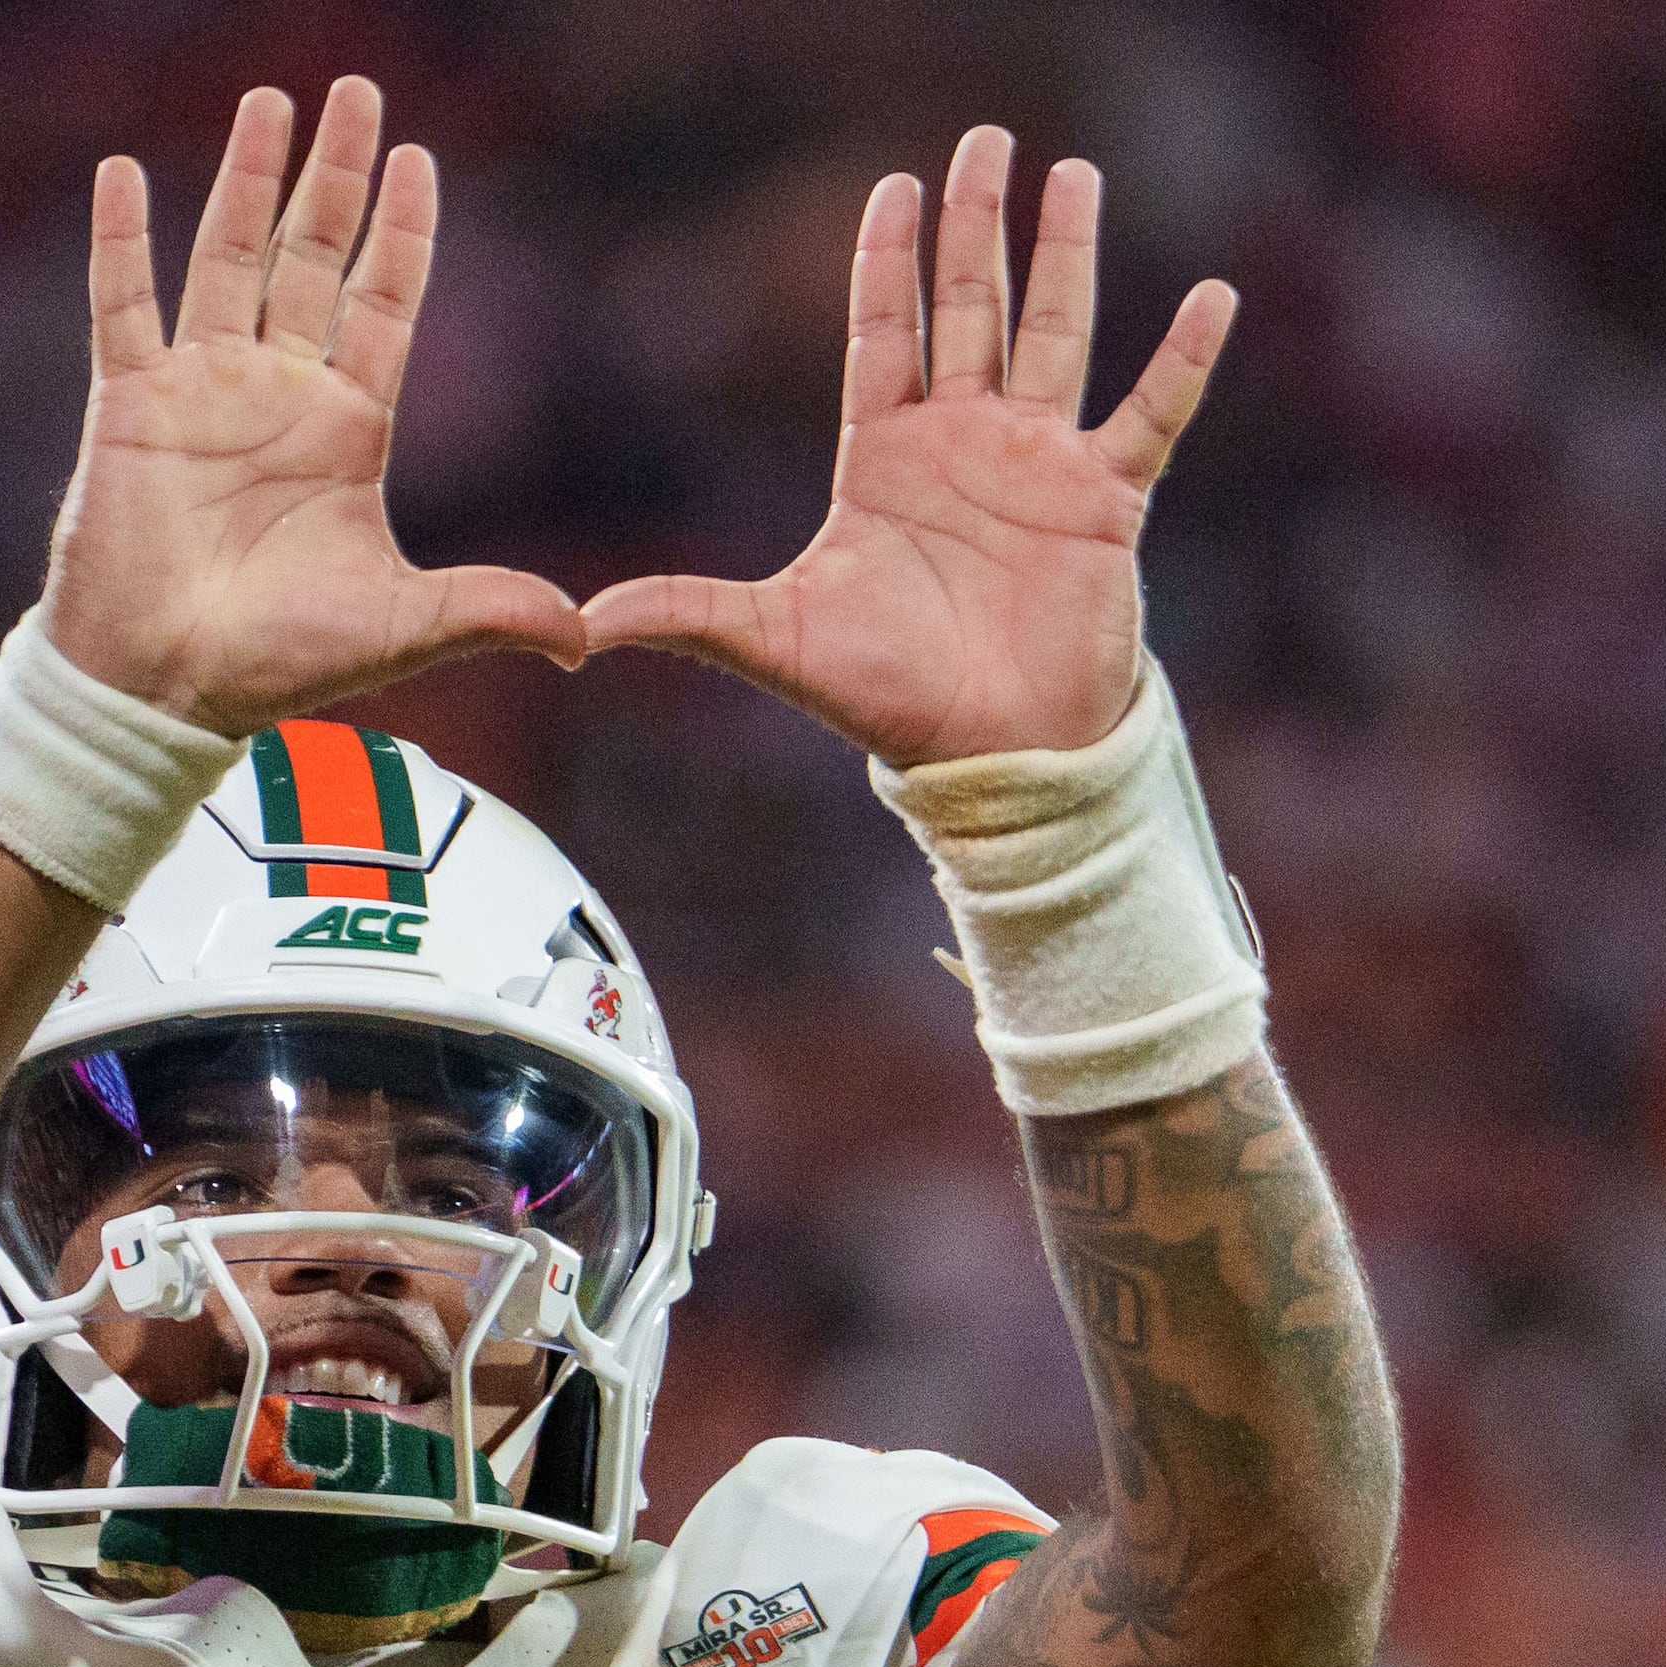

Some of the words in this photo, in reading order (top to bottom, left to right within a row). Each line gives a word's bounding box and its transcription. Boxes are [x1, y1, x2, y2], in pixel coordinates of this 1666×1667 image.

[275, 905, 429, 955] ACC
[110, 1238, 146, 1271] U
[547, 1262, 575, 1296] U
[244, 1394, 391, 1491] U
[681, 1621, 748, 1661] MIRA
[749, 1600, 794, 1626] SR.
